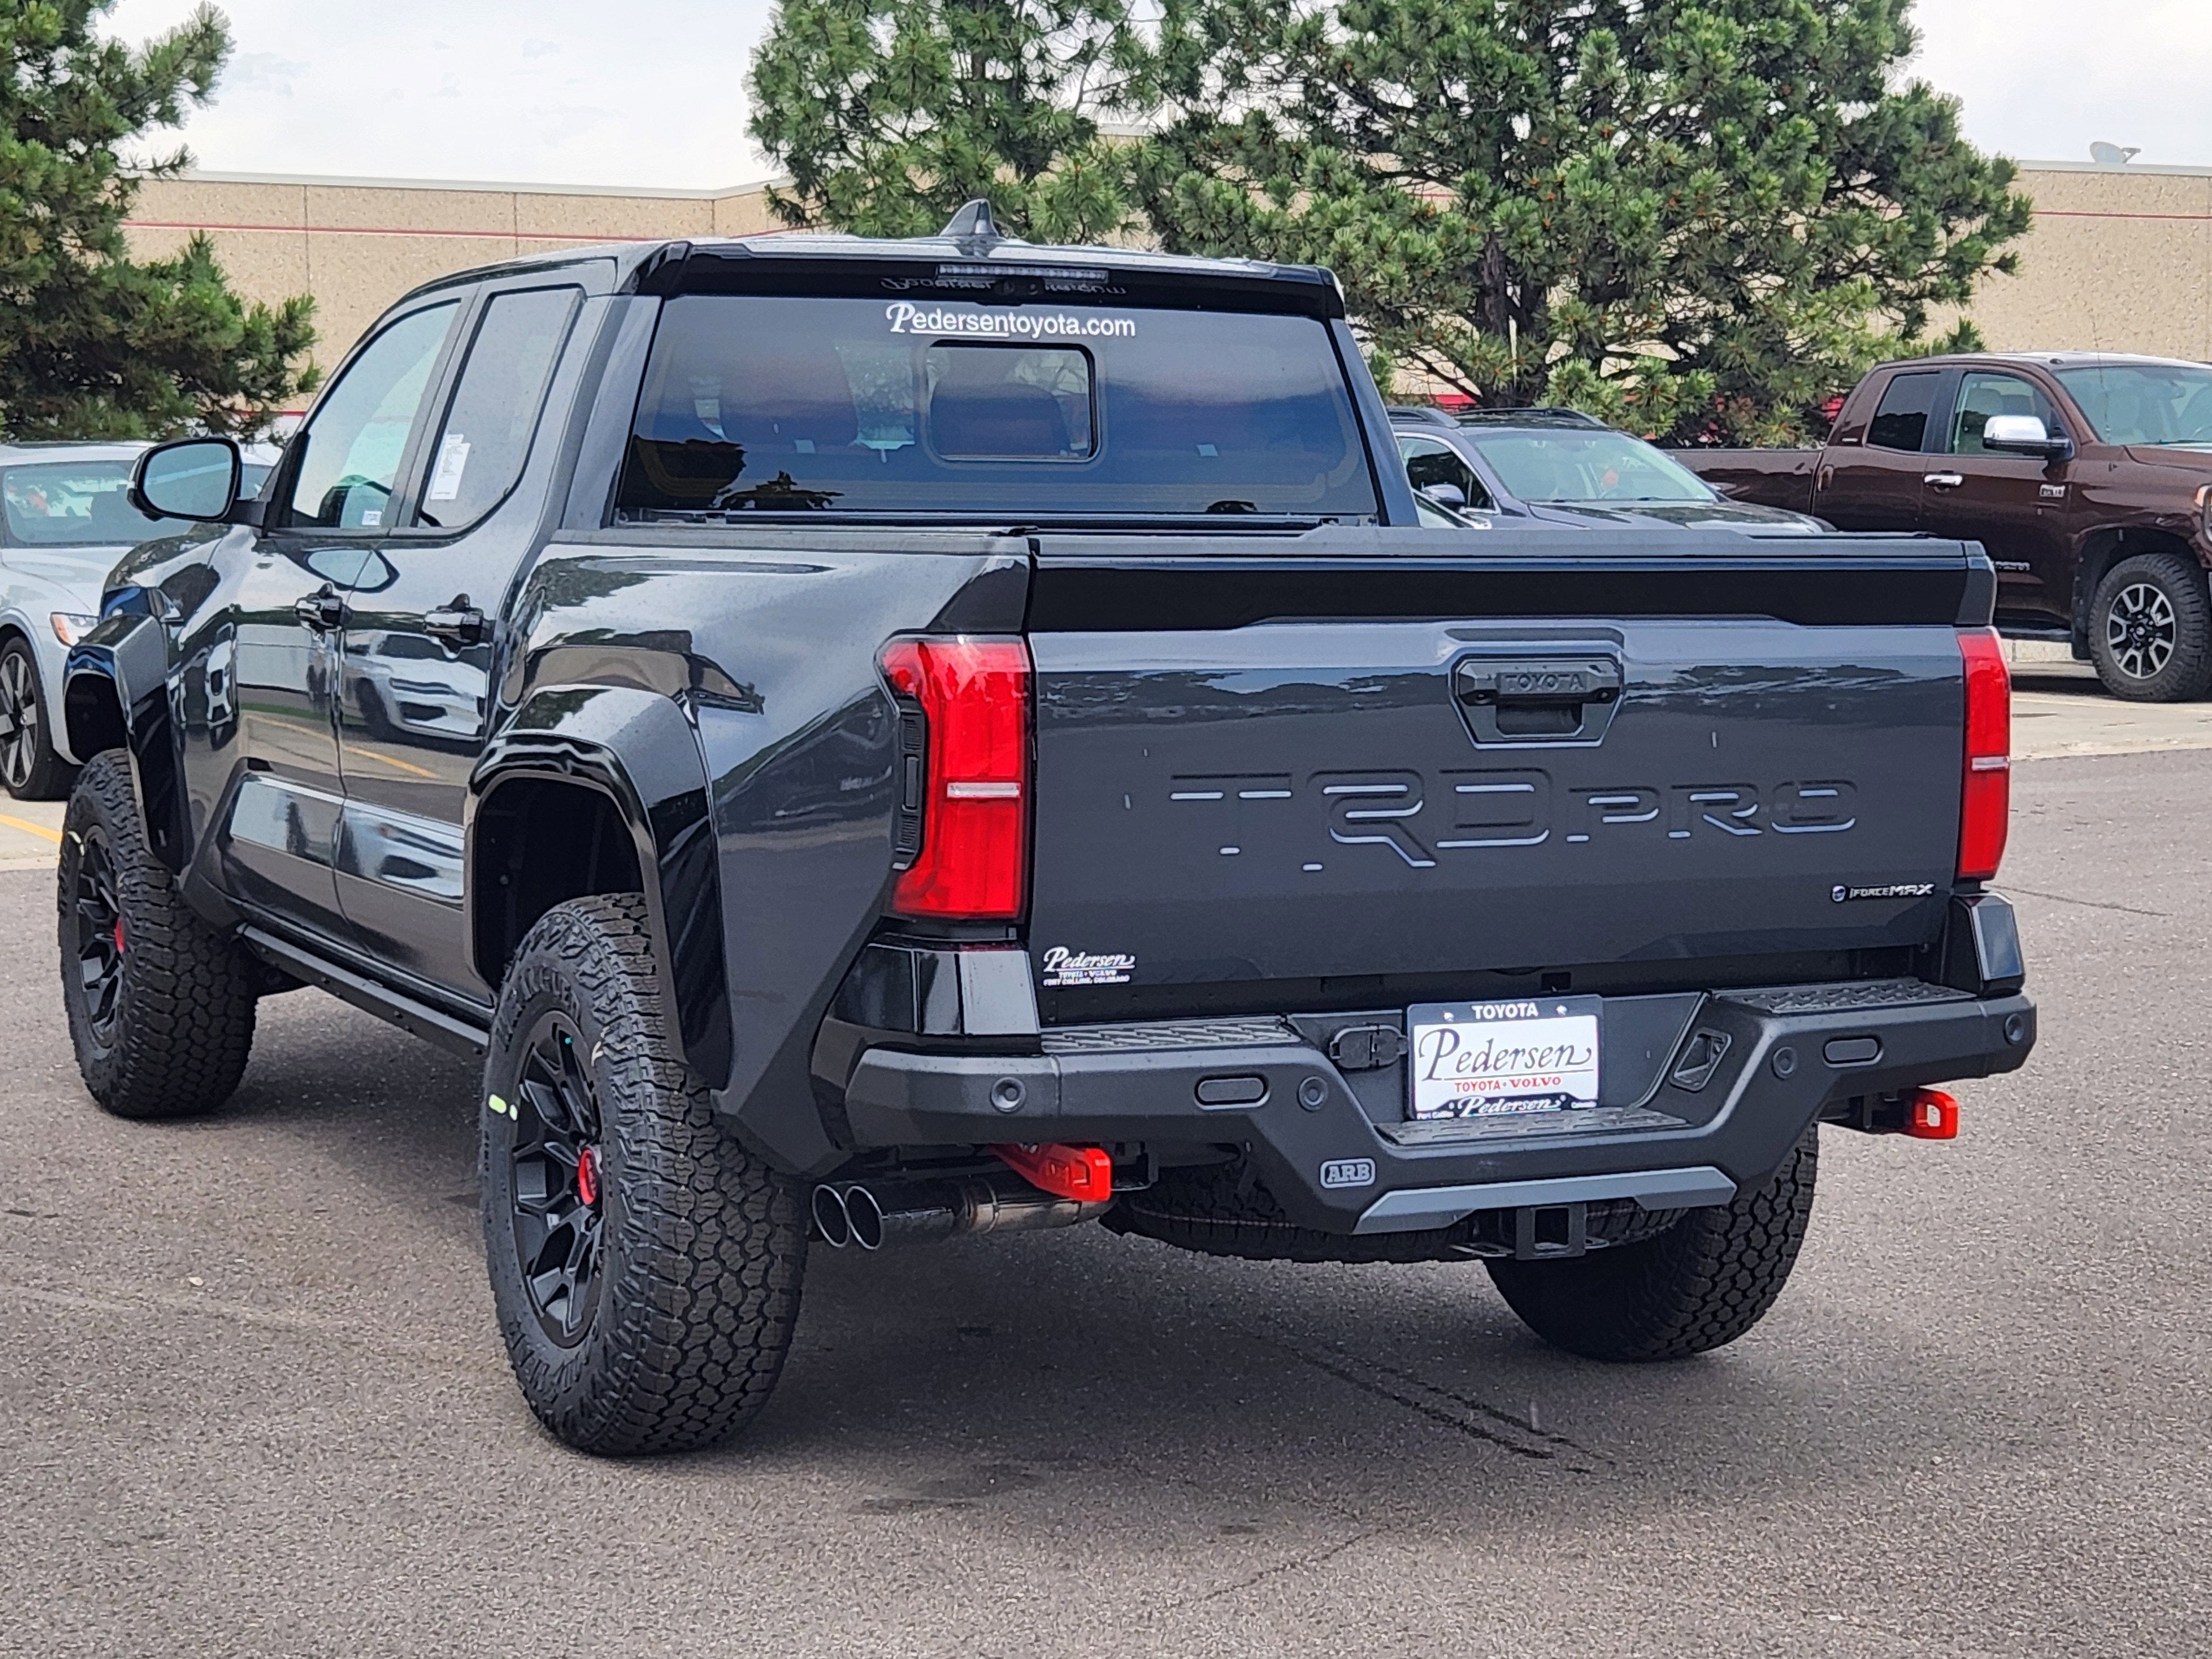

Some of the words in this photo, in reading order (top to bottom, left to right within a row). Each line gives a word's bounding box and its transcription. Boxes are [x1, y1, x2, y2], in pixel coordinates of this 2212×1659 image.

[886, 302, 1136, 338] Pedersentoyota.com
[1505, 674, 1584, 691] TOYOTA
[1043, 946, 1135, 972] Pedersen
[1472, 1002, 1538, 1020] TOYOTA
[1418, 1027, 1593, 1081] Pedersen
[1454, 1081, 1500, 1093] TOYOTA
[1510, 1077, 1561, 1089] VOLVO
[1458, 1095, 1562, 1118] Pedersen
[1327, 1164, 1370, 1183] ARB
